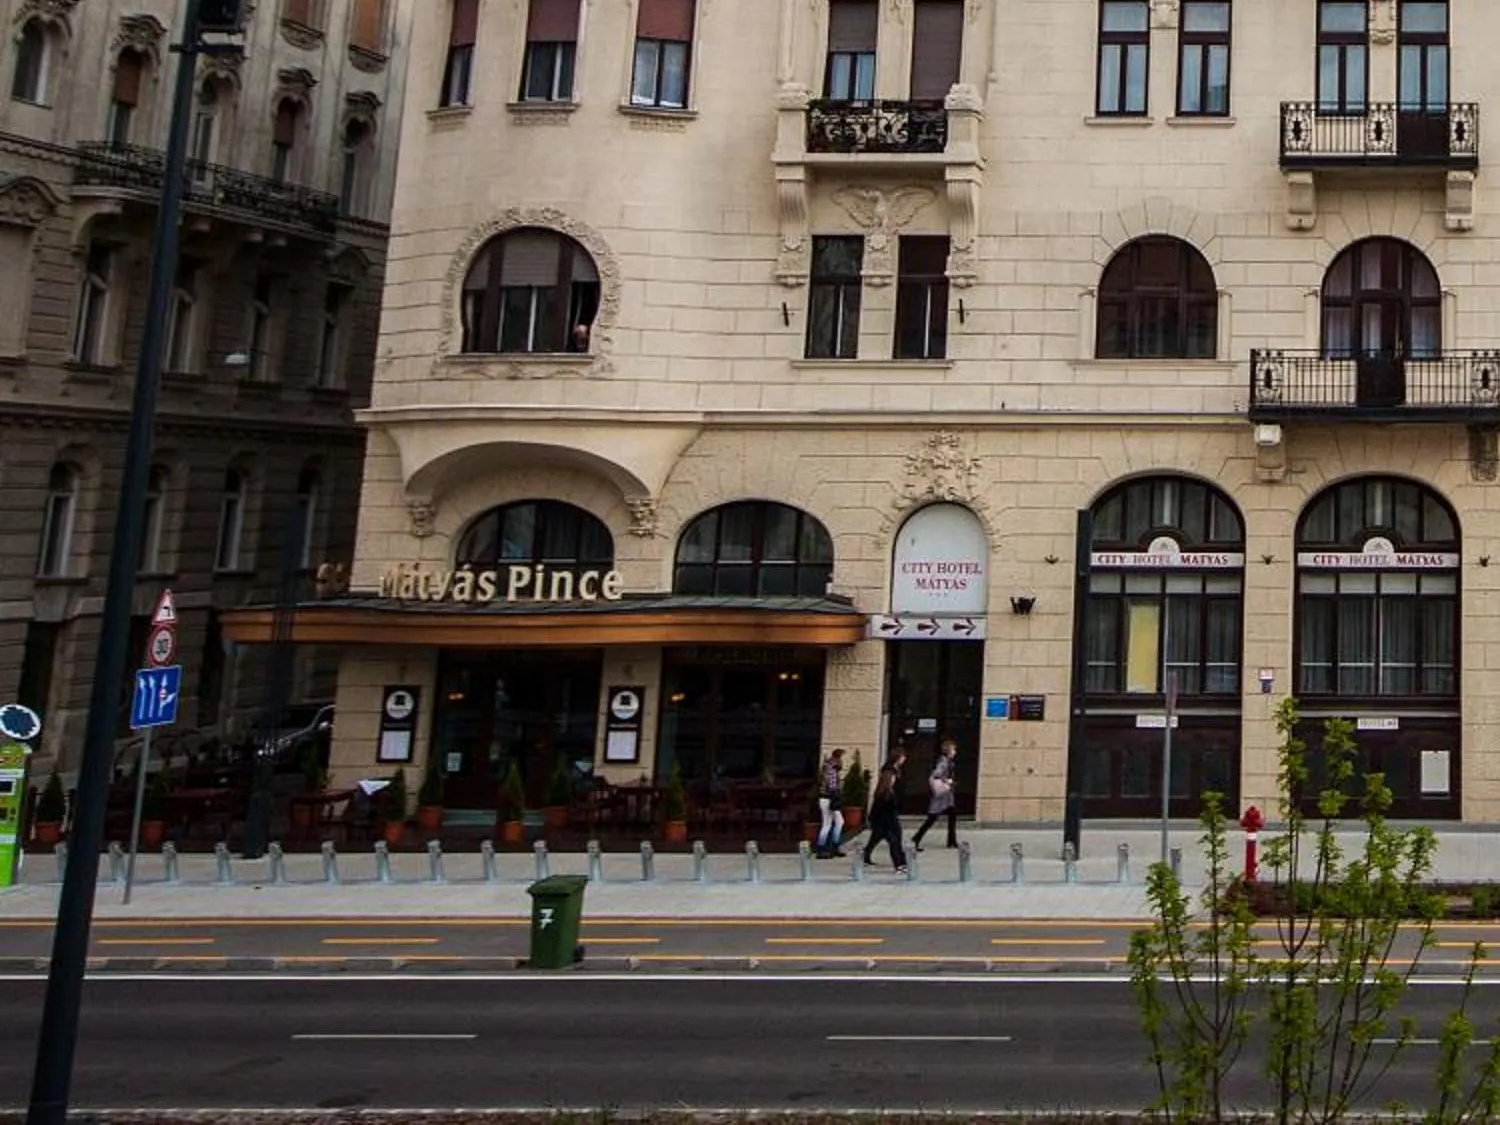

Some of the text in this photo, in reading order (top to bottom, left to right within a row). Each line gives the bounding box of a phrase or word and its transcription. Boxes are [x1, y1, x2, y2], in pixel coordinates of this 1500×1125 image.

[1098, 554, 1125, 564] CITY
[1133, 554, 1172, 564] HOTEL
[1313, 554, 1341, 565] CITY
[1349, 554, 1388, 565] HOTEL
[902, 562, 982, 574] CITY HOTEL
[508, 565, 625, 602] Pince
[540, 908, 554, 930] 7
